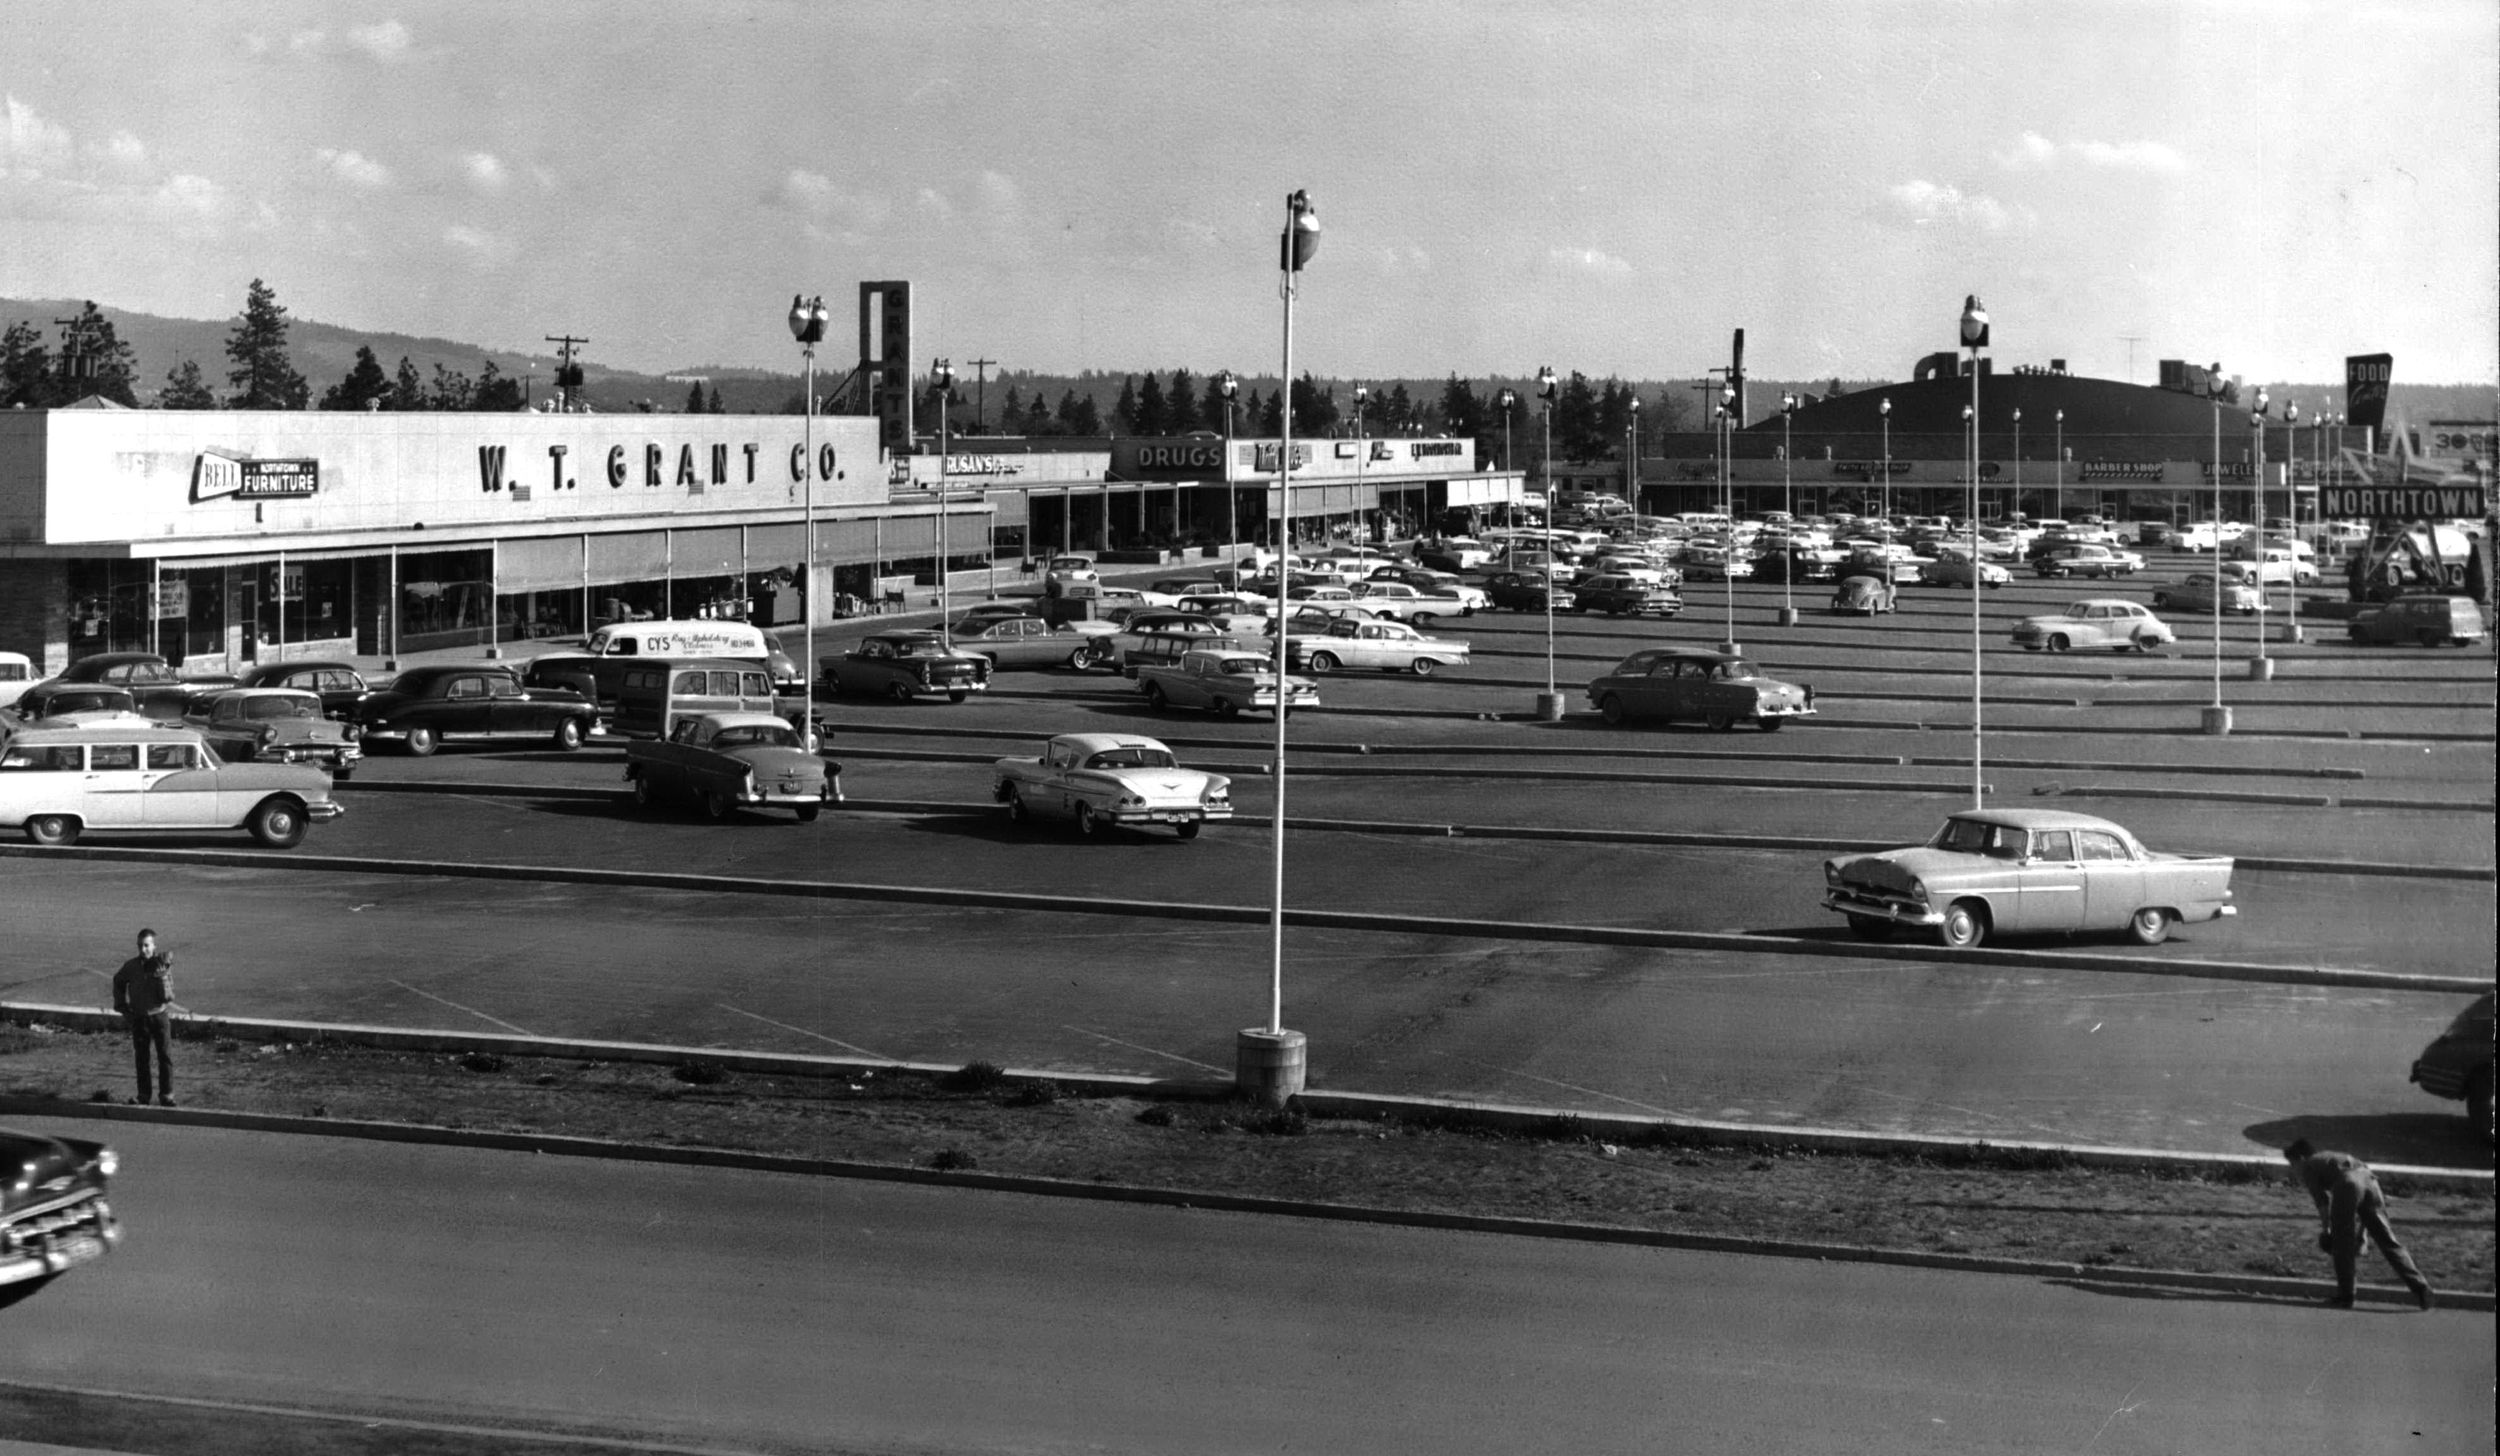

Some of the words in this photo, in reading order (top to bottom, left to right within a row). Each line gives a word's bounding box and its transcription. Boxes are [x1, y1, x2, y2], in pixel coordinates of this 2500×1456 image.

[886, 289, 905, 440] GRANTS
[2349, 363, 2389, 382] FOOD
[478, 444, 517, 493] W.
[548, 444, 576, 491] T.
[606, 442, 760, 489] GRANT
[789, 441, 845, 483] CO.
[1138, 447, 1222, 466] DRUGS
[2085, 463, 2131, 472] BARBER
[2133, 463, 2162, 472] SHOP
[204, 463, 239, 488] BELL
[244, 474, 315, 492] FURNITURE
[2326, 489, 2479, 515] NORTHTOWN
